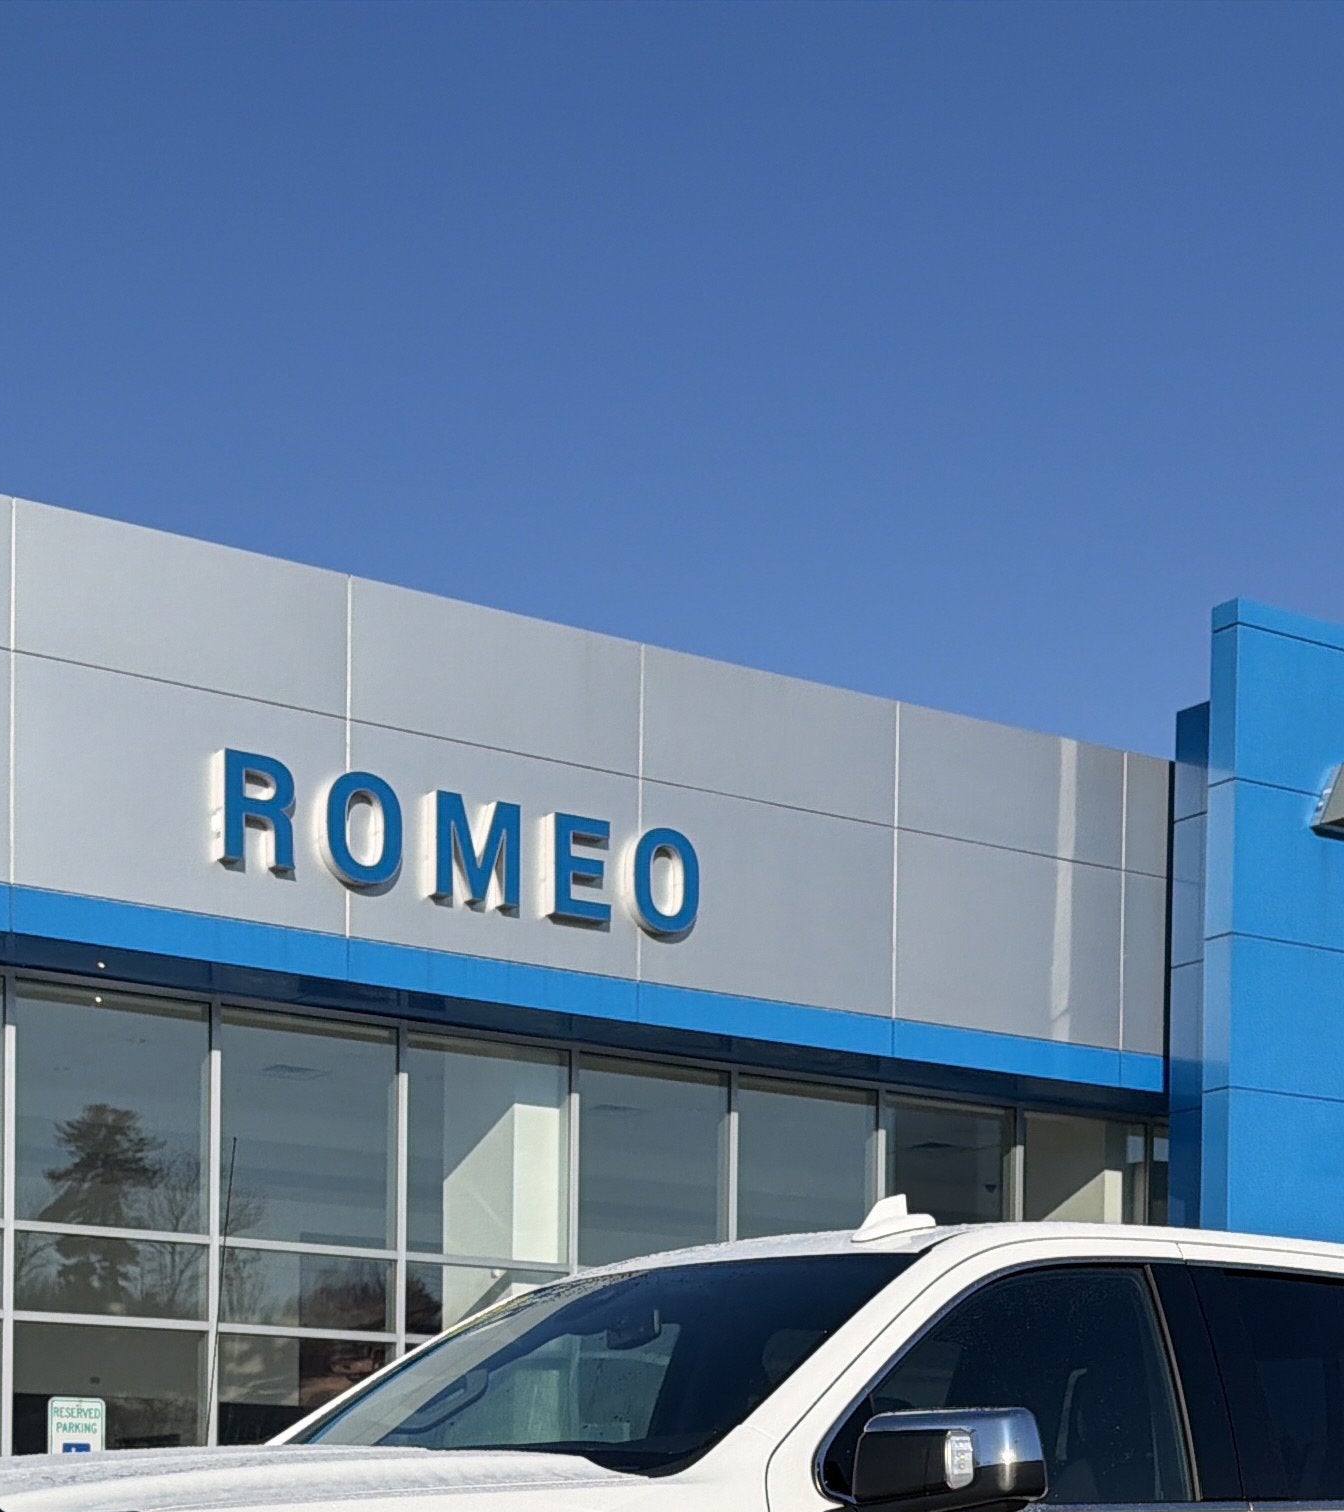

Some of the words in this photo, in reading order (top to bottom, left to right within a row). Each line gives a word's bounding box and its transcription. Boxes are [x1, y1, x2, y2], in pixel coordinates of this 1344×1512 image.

[220, 747, 701, 936] ROMEO
[52, 1406, 101, 1420] RESERVED
[56, 1421, 98, 1434] PARKING
